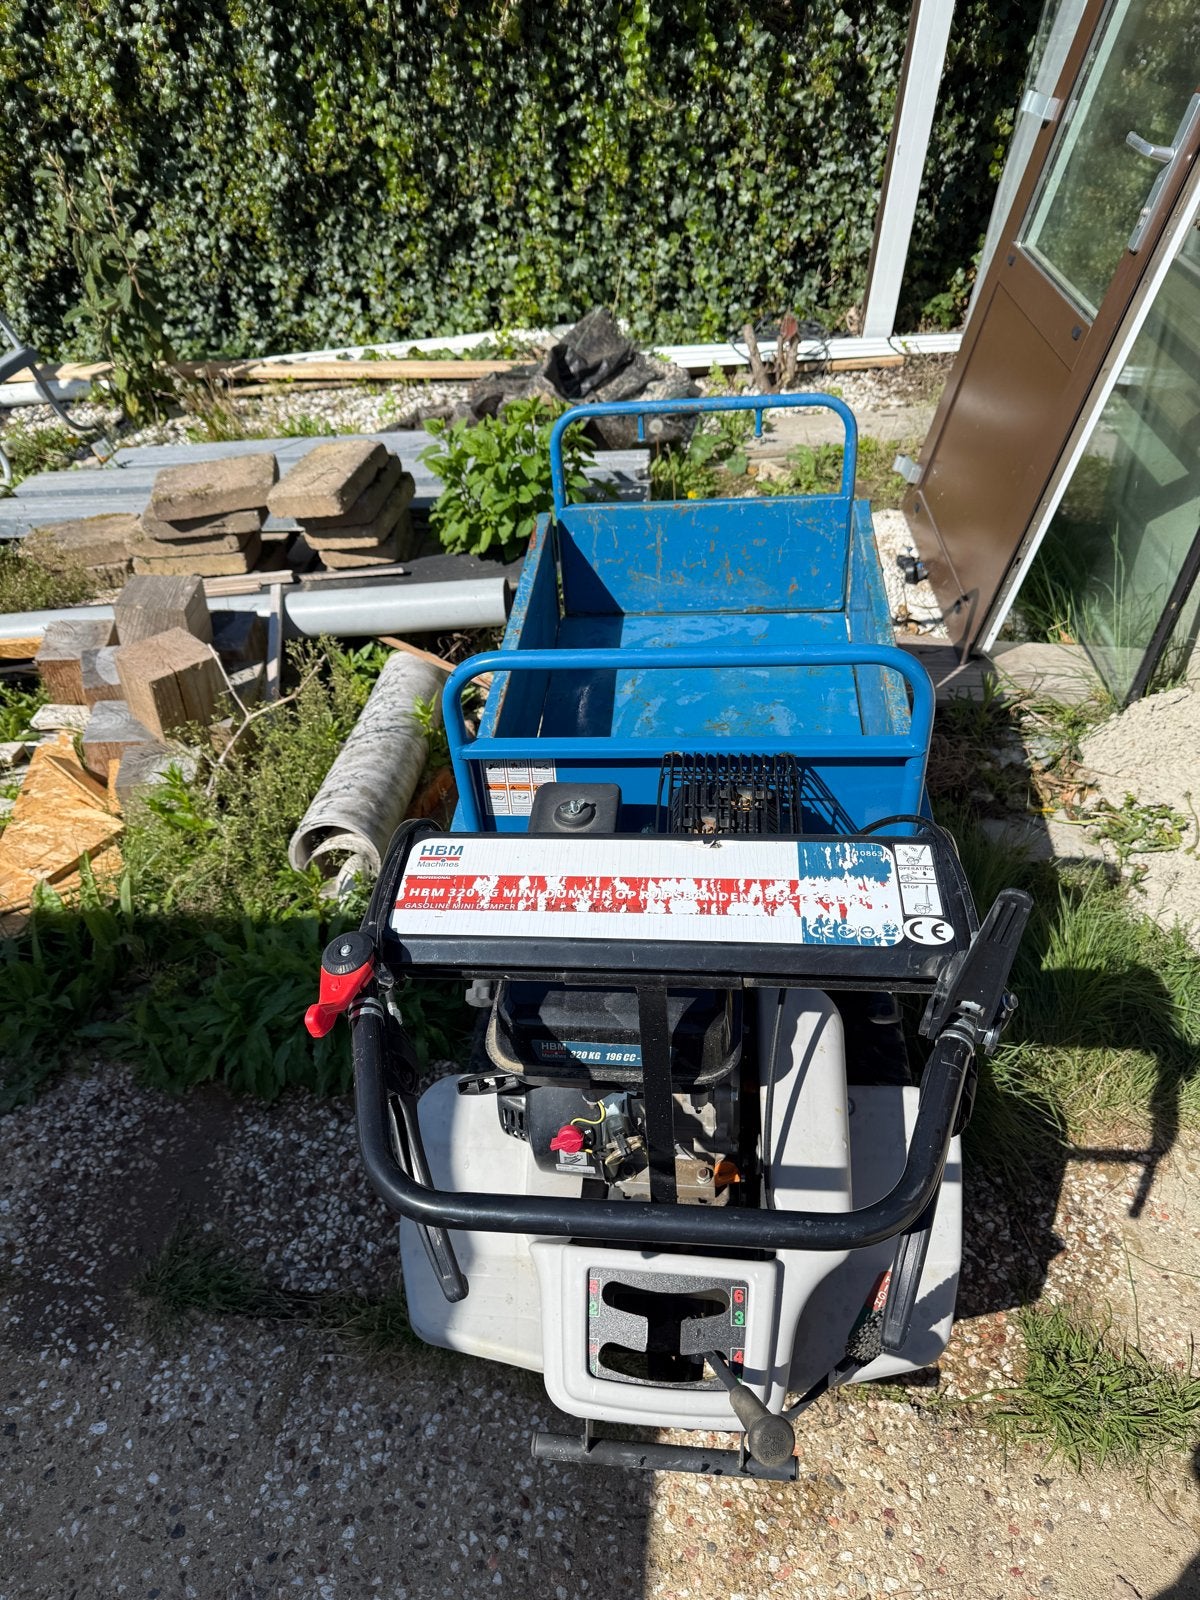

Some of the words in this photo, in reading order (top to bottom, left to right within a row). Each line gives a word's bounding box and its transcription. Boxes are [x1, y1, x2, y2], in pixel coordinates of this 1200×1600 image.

[420, 845, 464, 856] HBM
[409, 888, 445, 897] HBM
[448, 888, 475, 897] 320
[478, 888, 499, 898] KG
[503, 888, 541, 898] MINI
[544, 889, 613, 899] DUMPER
[615, 889, 637, 900] OP
[908, 920, 947, 941] CE
[541, 1042, 567, 1051] HBM
[588, 1051, 602, 1061] KG
[605, 1052, 622, 1062] 196
[622, 1053, 637, 1063] CC
[734, 1289, 744, 1304] 6
[734, 1310, 744, 1325] 3
[733, 1350, 744, 1364] 4
